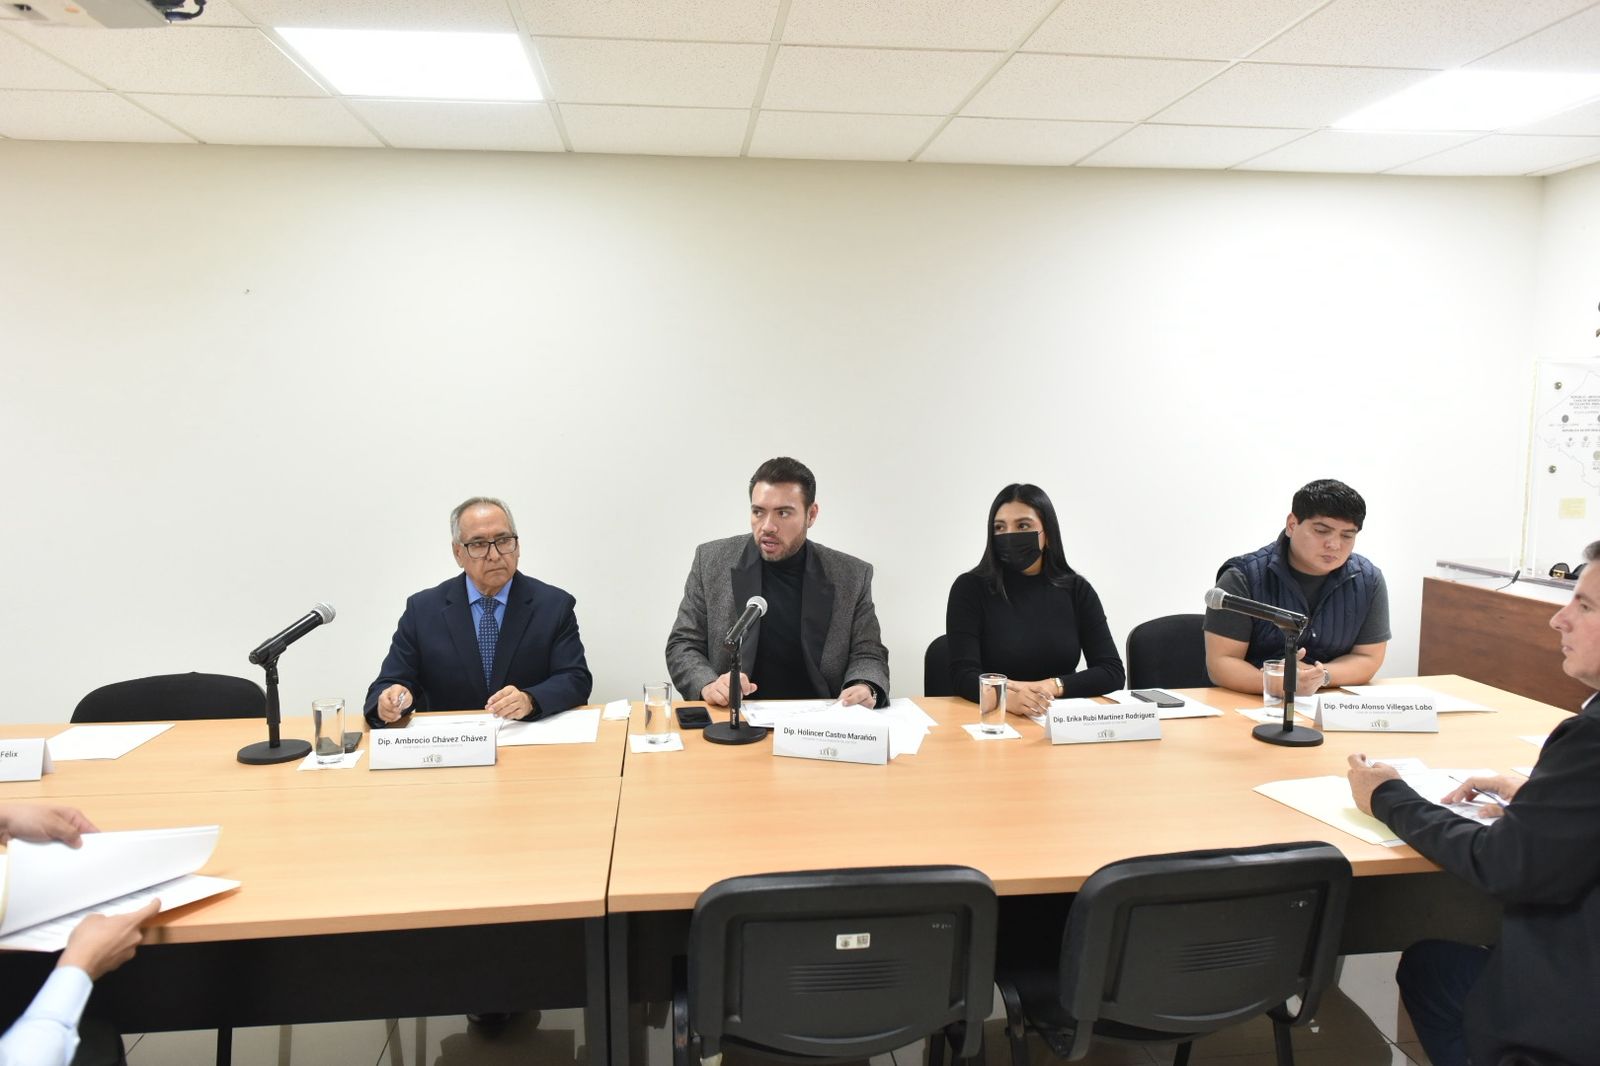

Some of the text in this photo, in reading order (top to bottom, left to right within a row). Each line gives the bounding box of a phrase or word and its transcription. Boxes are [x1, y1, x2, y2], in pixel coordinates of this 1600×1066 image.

[1324, 703, 1337, 711] Dip.
[1386, 703, 1414, 711] Villegas
[1415, 703, 1433, 711] Lobo
[1053, 715, 1065, 724] Dip.
[1066, 714, 1082, 723] Erika
[783, 727, 796, 736] Dip.
[825, 730, 847, 739] Castro
[377, 734, 488, 747] Dip. Ambrocio Chávez Chávez
